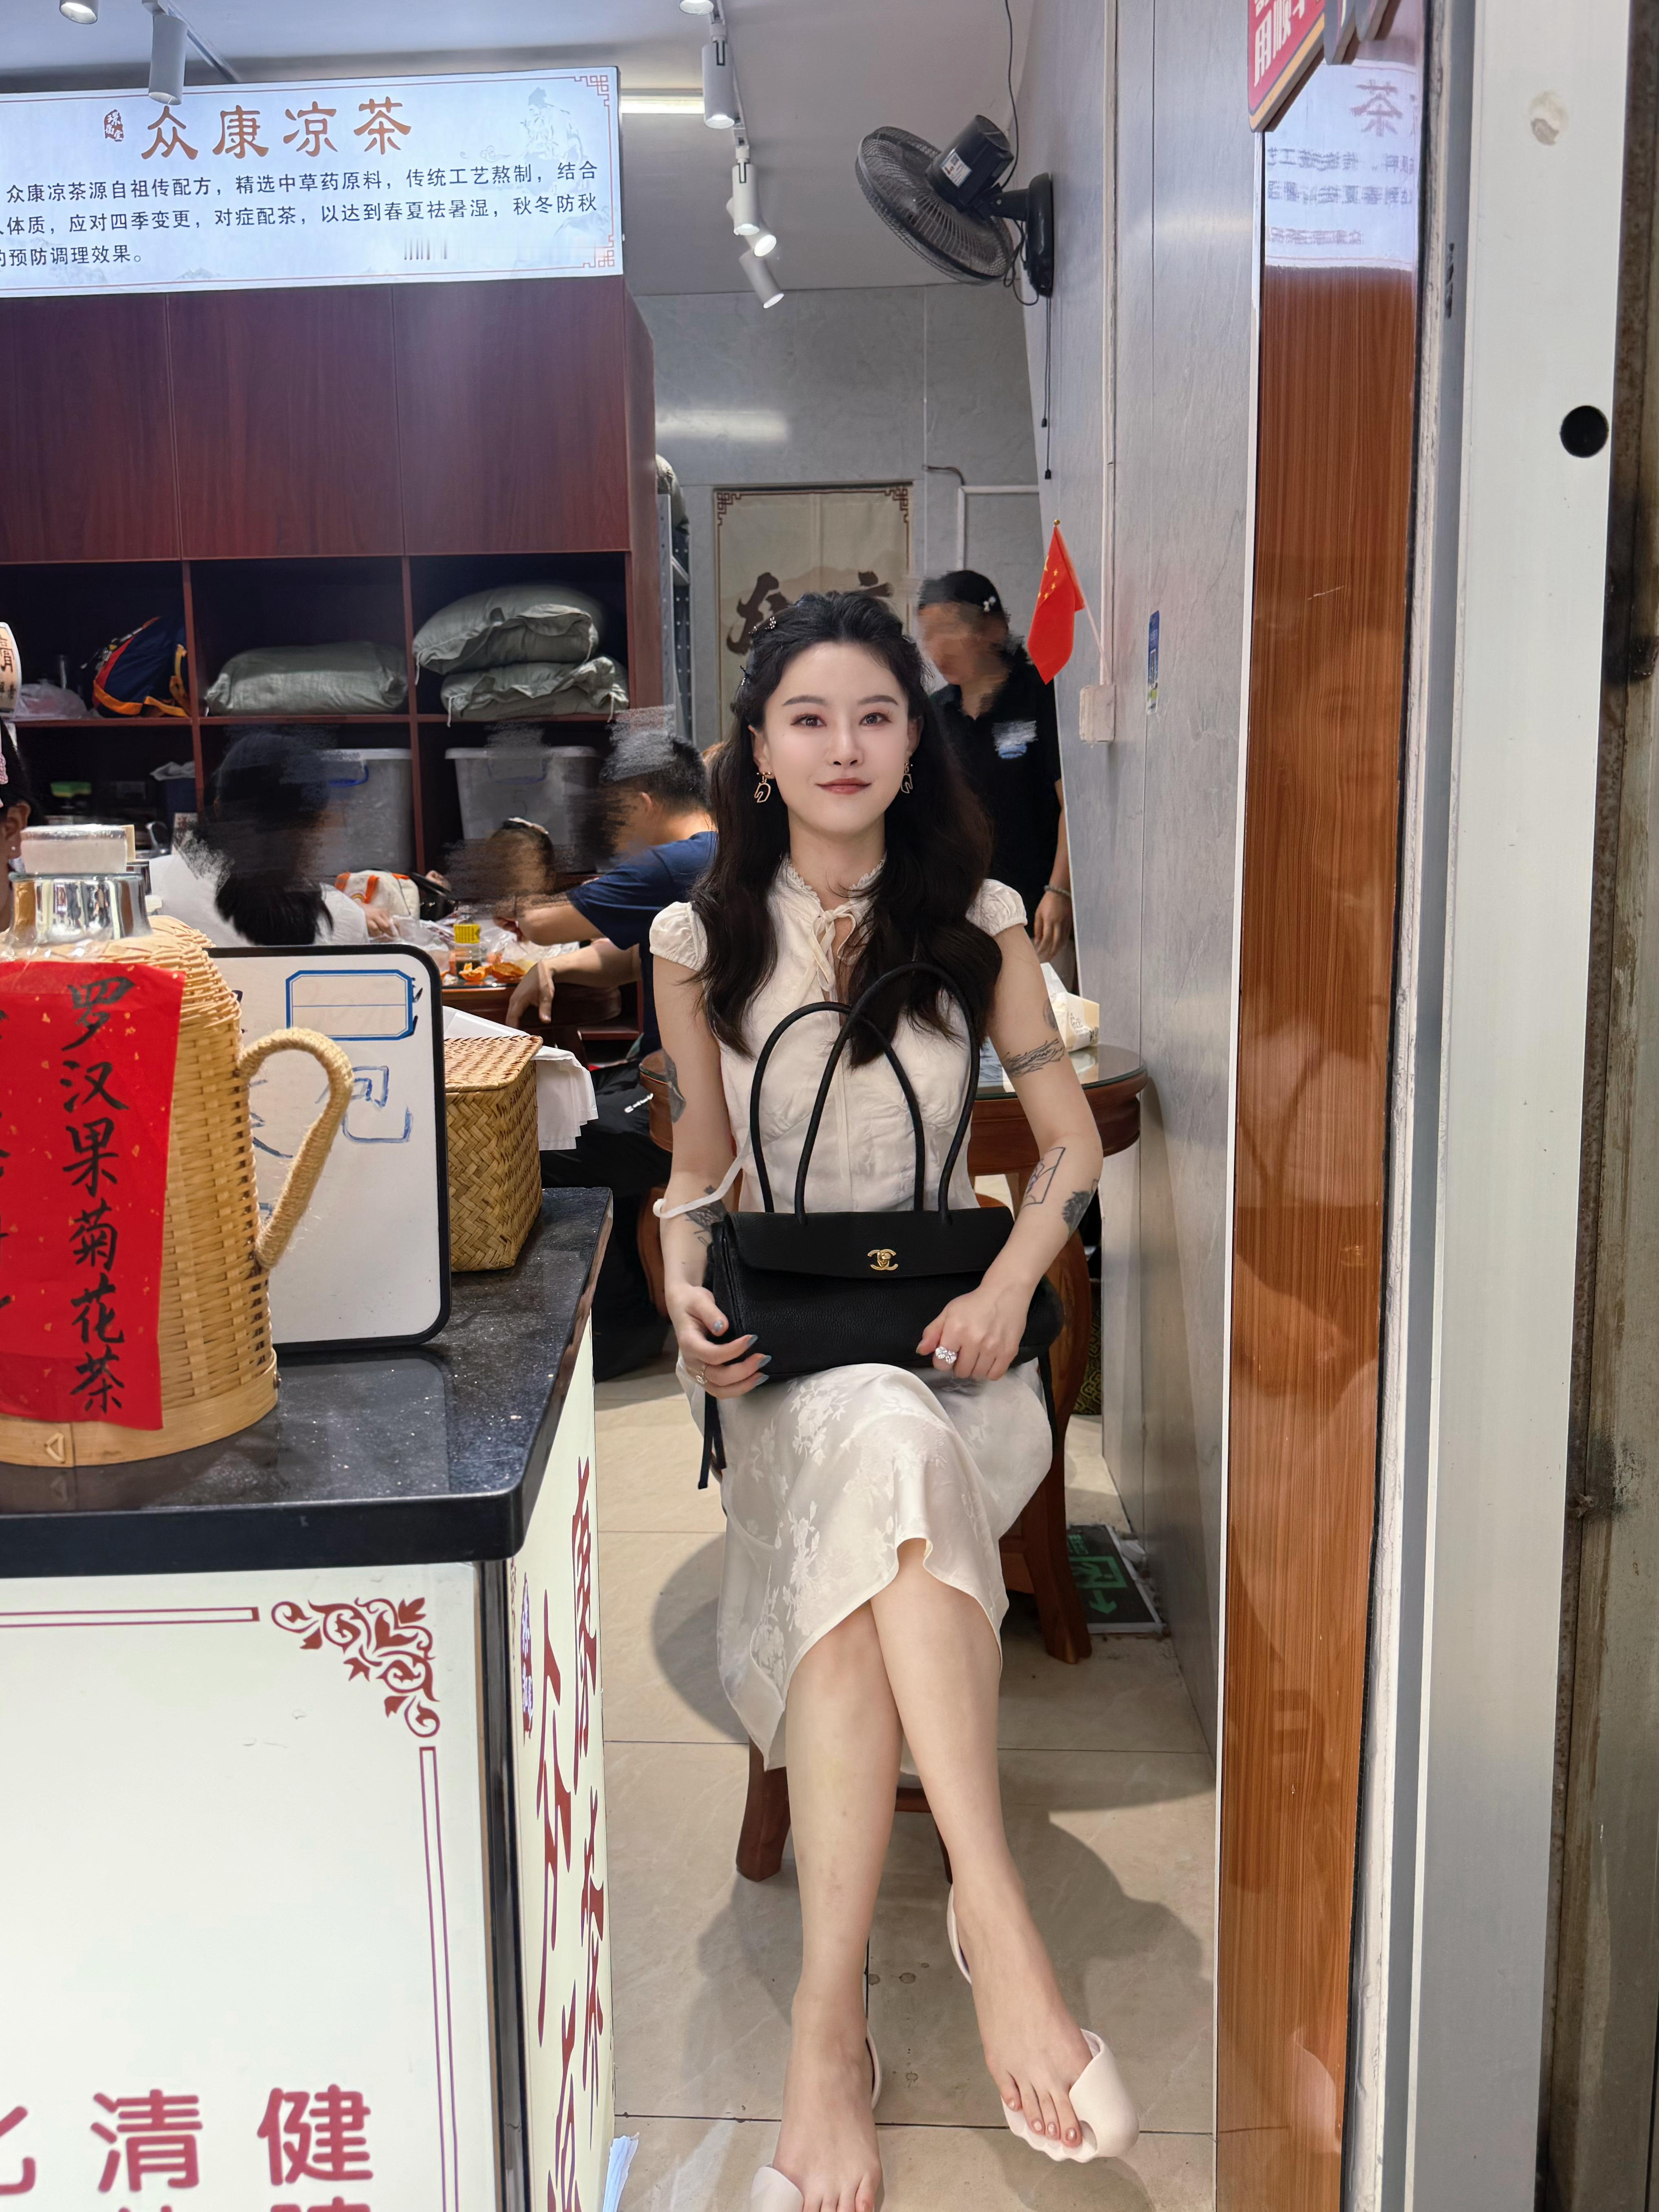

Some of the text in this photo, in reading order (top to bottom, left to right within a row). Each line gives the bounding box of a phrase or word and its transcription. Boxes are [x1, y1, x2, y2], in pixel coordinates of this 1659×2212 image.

[6, 160, 597, 203] 众康凉茶源自祖传配方，精选中草药原料，传统工艺熬制，结合
[141, 96, 411, 160] 众康凉茶
[60, 976, 135, 1414] 罗汉果菊花茶
[91, 2089, 203, 2212] 清
[257, 2084, 373, 2212] 健
